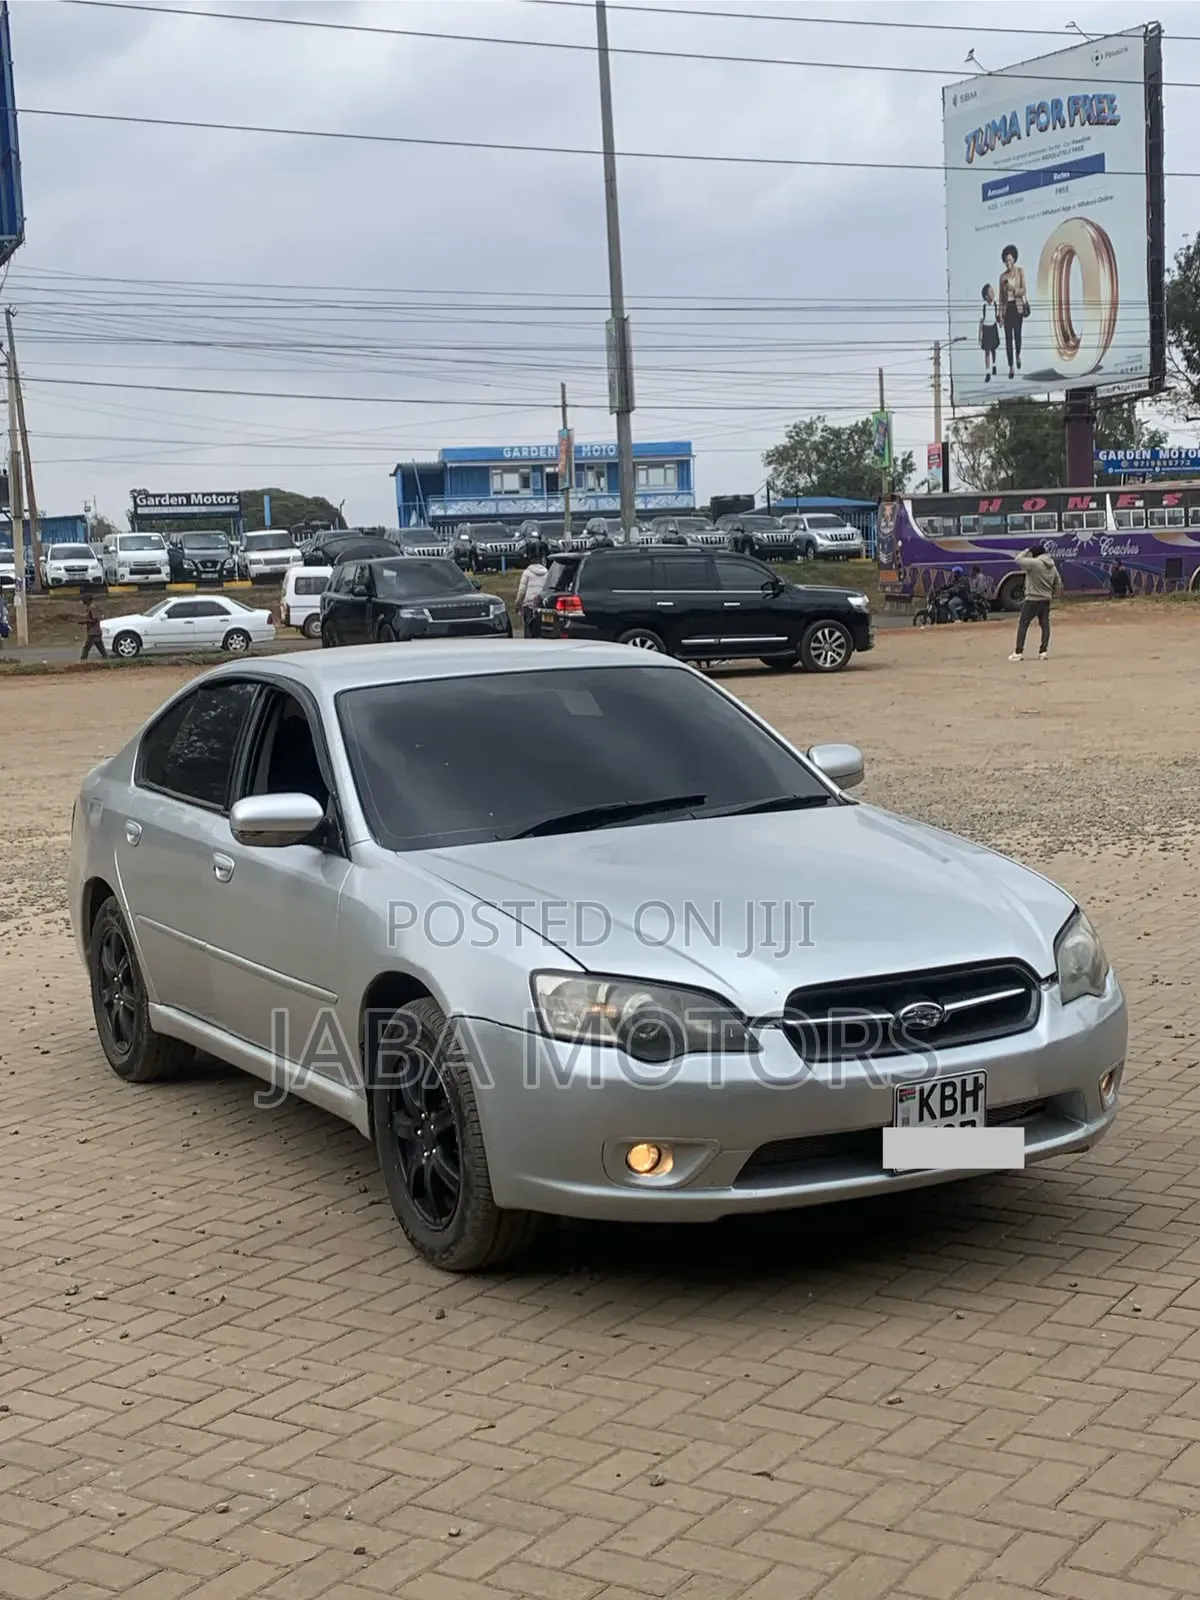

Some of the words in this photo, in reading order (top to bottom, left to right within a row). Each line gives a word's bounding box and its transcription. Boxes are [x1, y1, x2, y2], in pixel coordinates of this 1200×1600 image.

[959, 91, 978, 103] SBM
[964, 110, 1022, 164] TUMA
[1025, 97, 1066, 138] FOR
[1066, 93, 1121, 128] FREE
[1055, 186, 1069, 195] FREE
[503, 446, 557, 458] GARDEN
[1099, 449, 1151, 461] GARDEN
[1159, 449, 1200, 460] MOTO
[136, 493, 187, 506] Garden
[190, 493, 239, 505] Motors
[1100, 536, 1140, 556] Coaches
[918, 1076, 980, 1122] KBH
